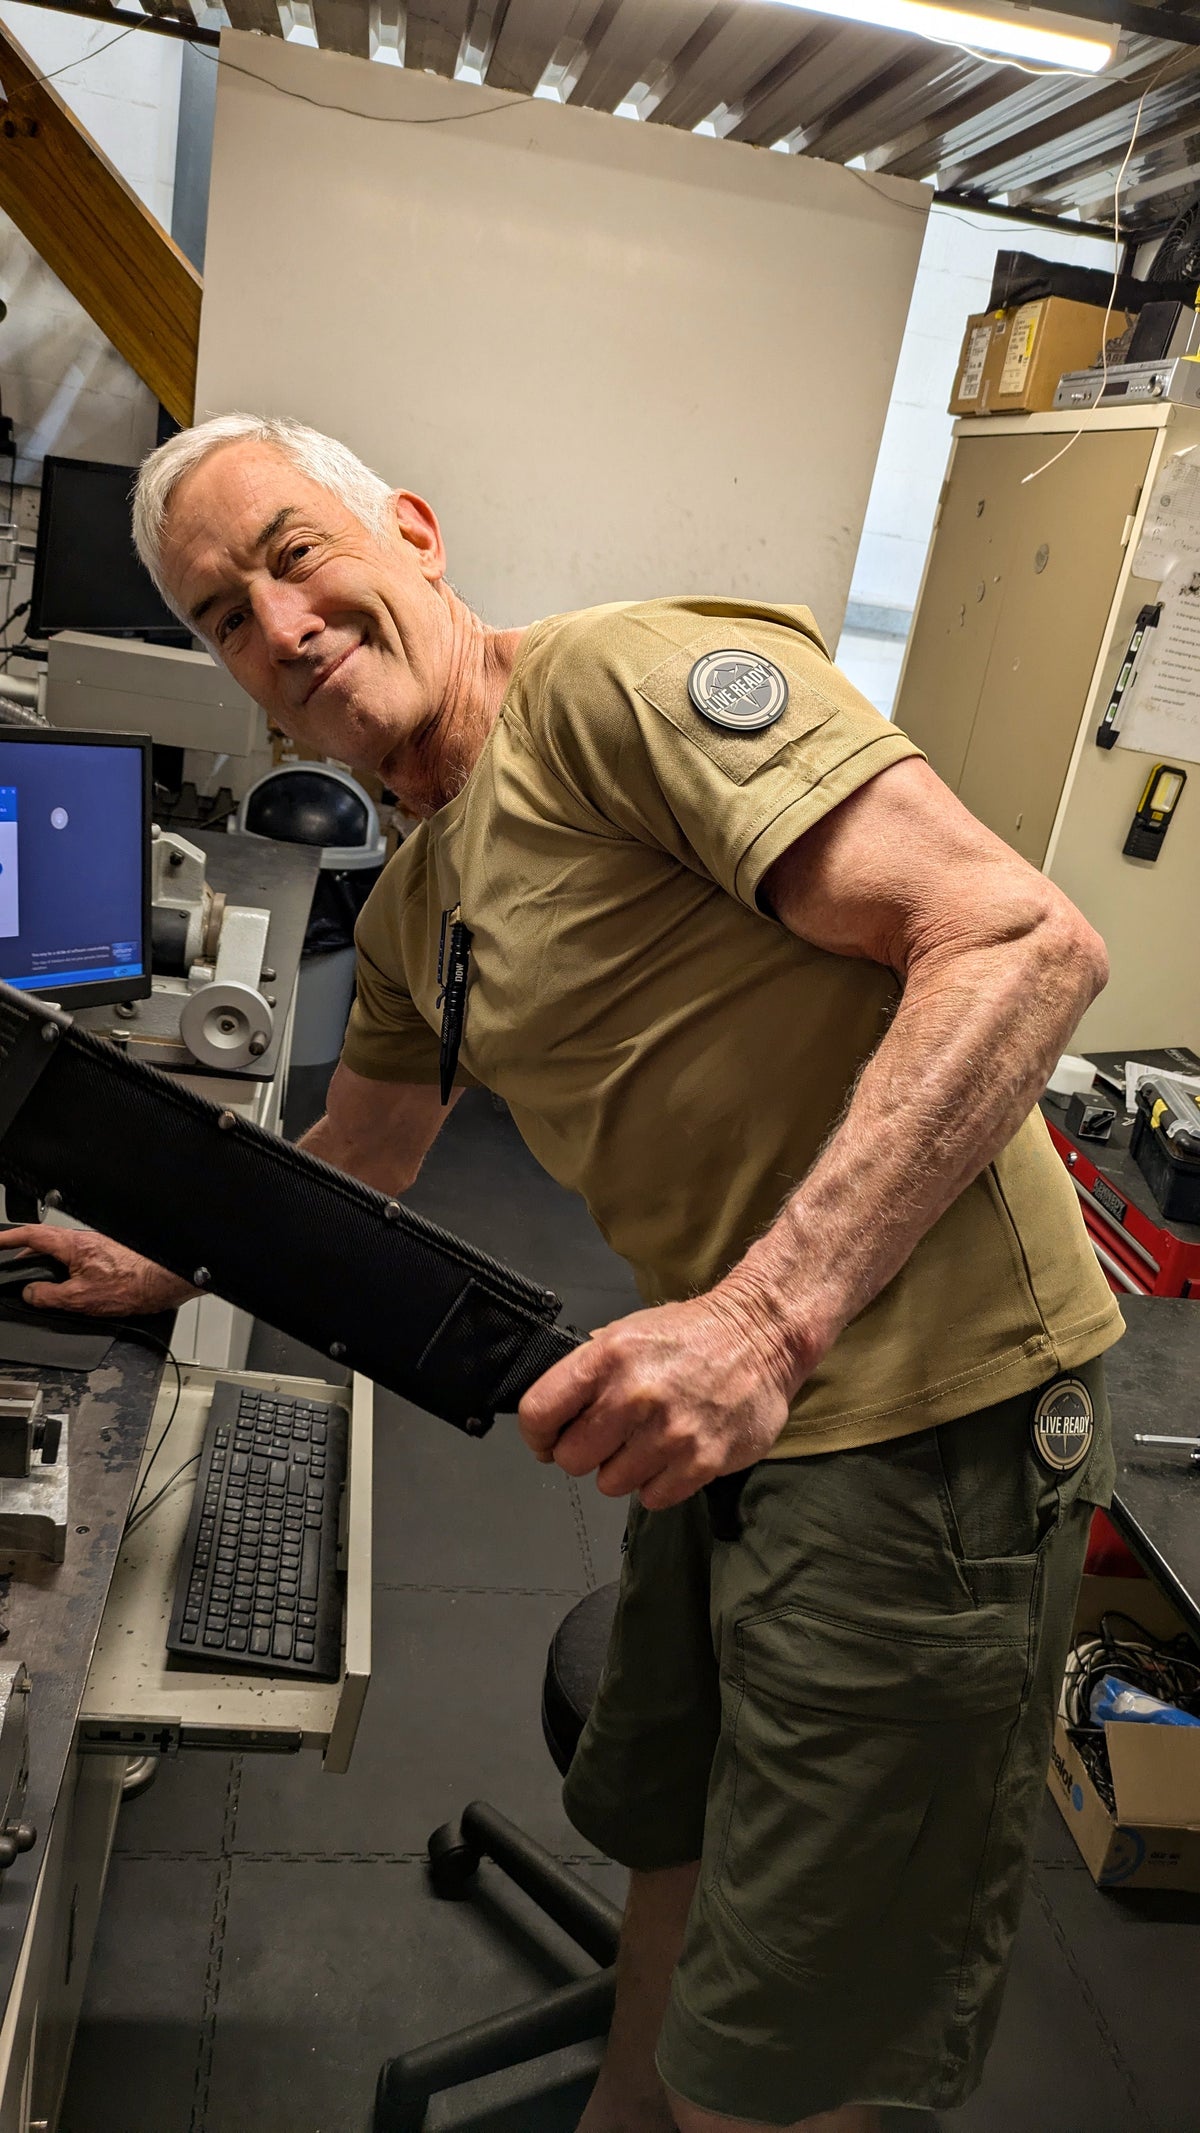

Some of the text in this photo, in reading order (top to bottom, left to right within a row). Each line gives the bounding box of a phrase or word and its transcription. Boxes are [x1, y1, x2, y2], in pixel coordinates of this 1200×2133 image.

[706, 665, 771, 713] LIVE READY
[454, 962, 464, 983] DOW
[1040, 1415, 1090, 1434] LIVE READY
